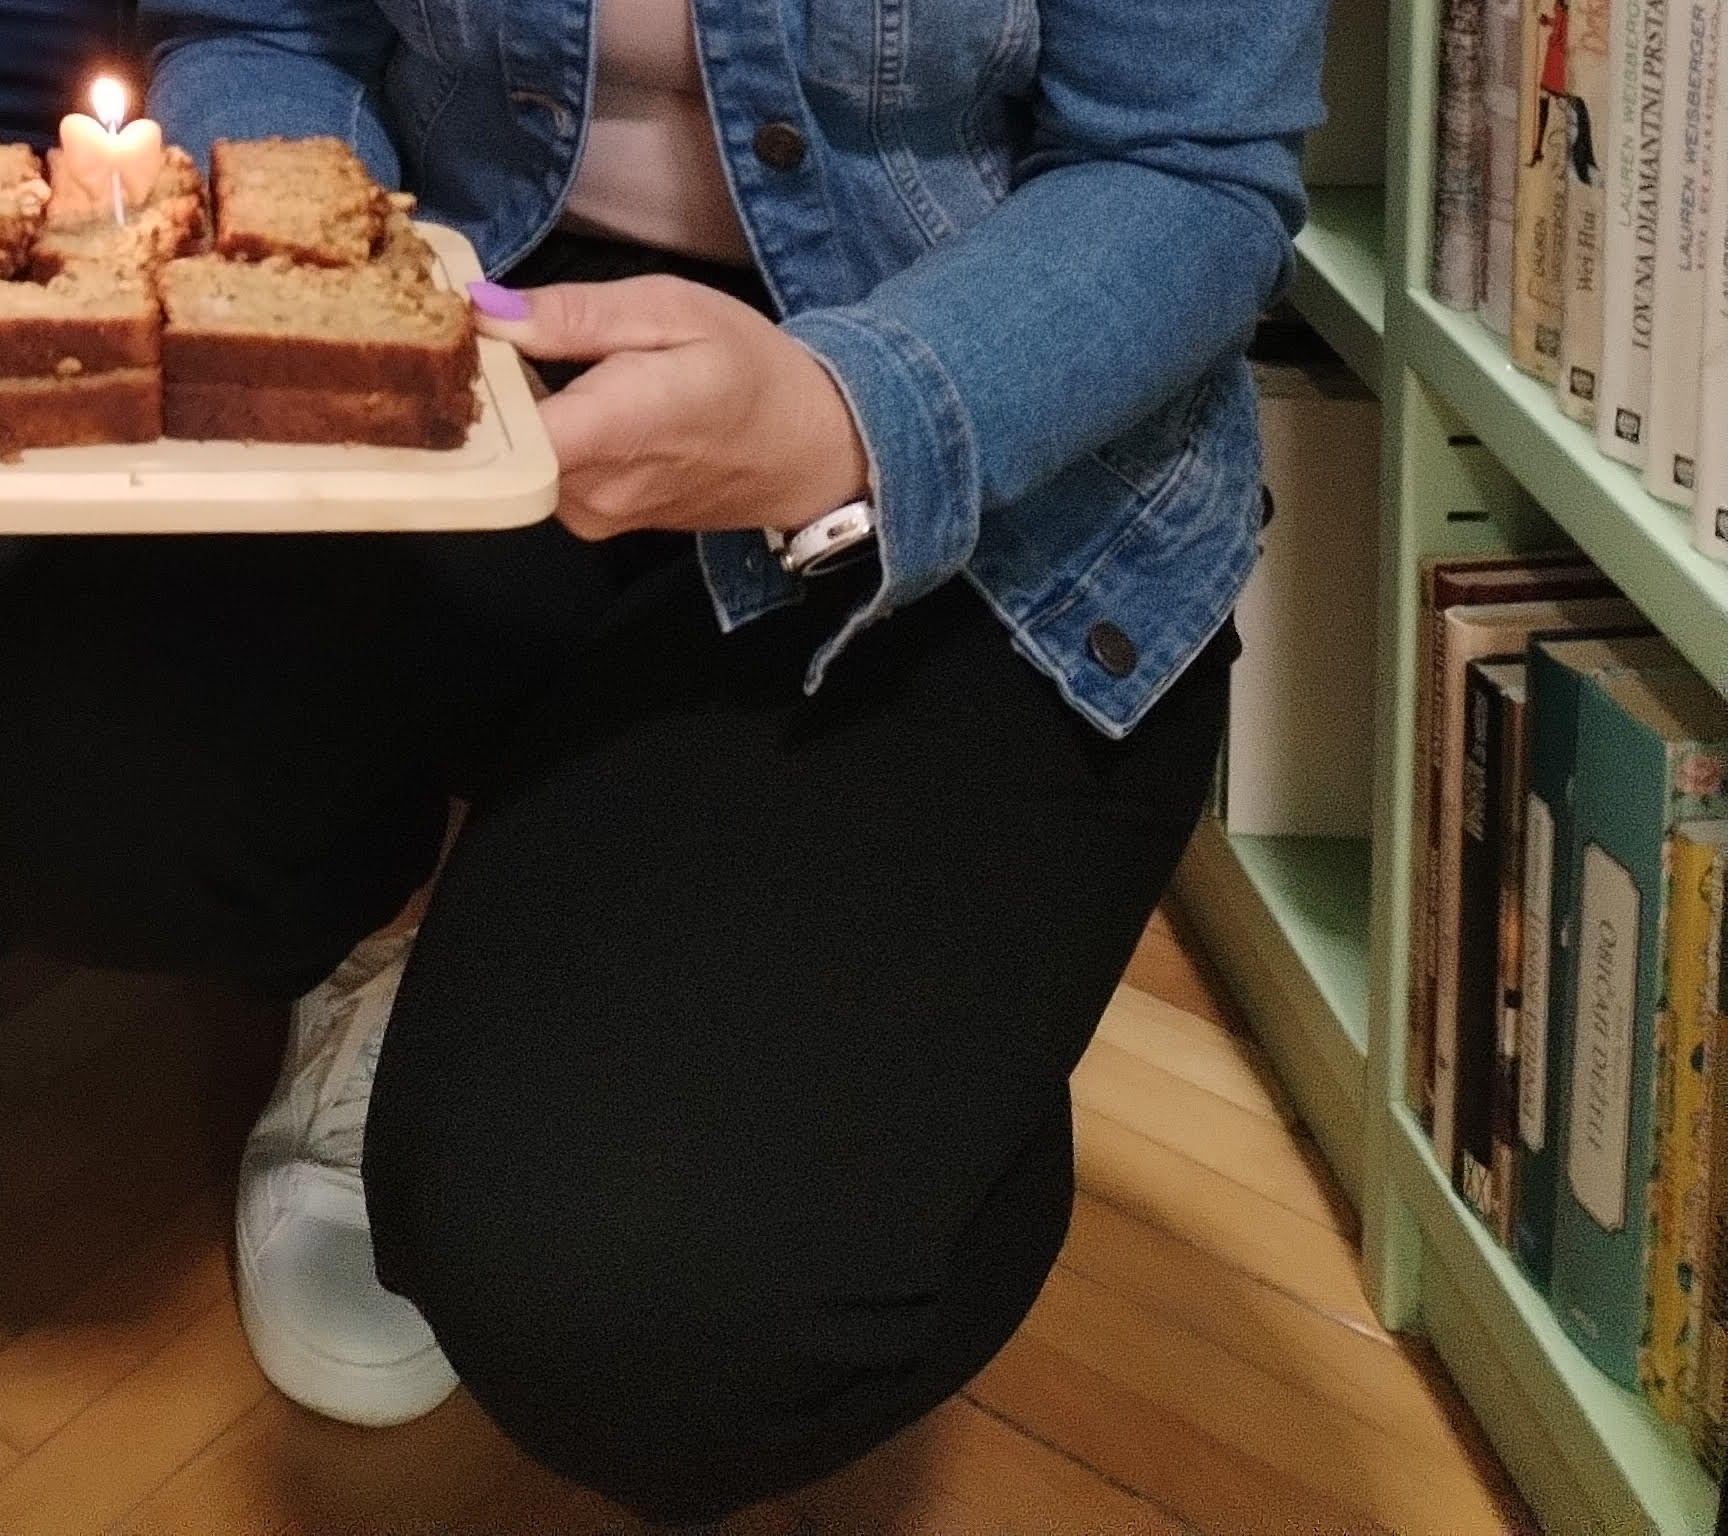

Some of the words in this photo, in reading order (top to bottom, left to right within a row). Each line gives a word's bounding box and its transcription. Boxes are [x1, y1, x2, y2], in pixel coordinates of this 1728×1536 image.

[1683, 3, 1706, 165] WEISBERGER
[1616, 130, 1634, 228] LAUREN
[1635, 84, 1664, 245] DIAMANTNI
[1575, 211, 1597, 249] Hui
[1633, 255, 1655, 289] NA
[1678, 175, 1696, 272] LAUREN
[1575, 260, 1595, 292] Wei
